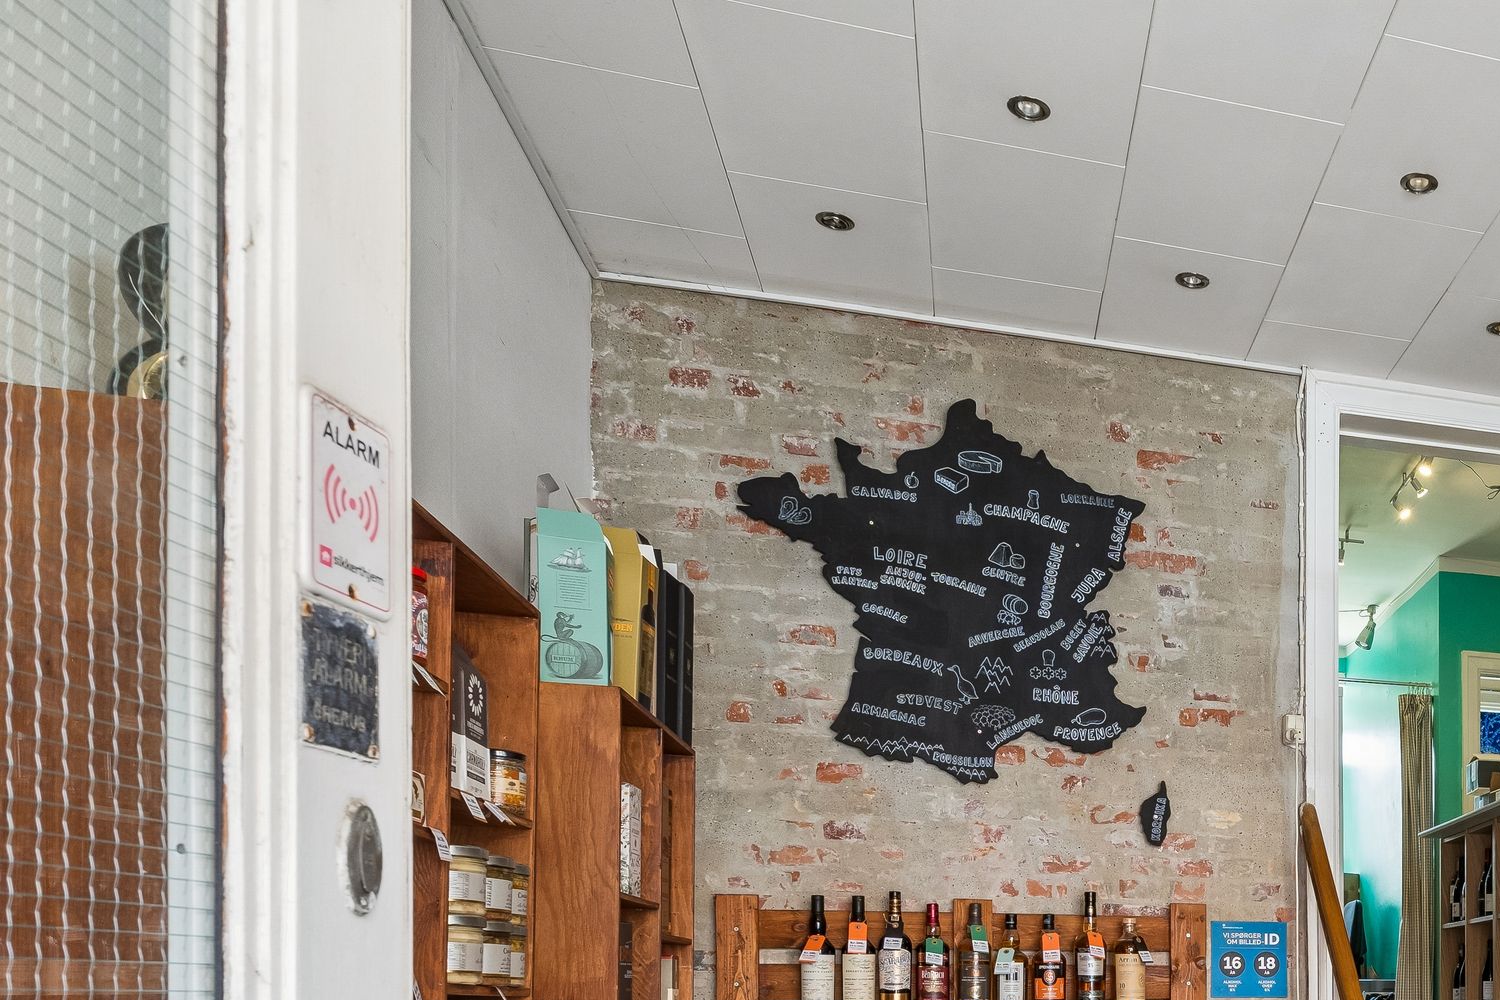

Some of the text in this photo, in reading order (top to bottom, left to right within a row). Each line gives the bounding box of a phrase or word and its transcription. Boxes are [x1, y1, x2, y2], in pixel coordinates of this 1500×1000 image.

[323, 421, 380, 469] ALARM
[852, 486, 918, 502] CALVADOS
[1061, 493, 1115, 508] LORRAINE
[984, 503, 1070, 534] CHAMPAGNE
[1107, 508, 1132, 562] ALSACE
[873, 546, 928, 570] LOIRE
[880, 574, 926, 595] SAUMUR
[931, 572, 986, 598] TOURAINE
[982, 566, 1025, 587] CENTRE
[1038, 543, 1064, 618] BOURGOGNE
[1071, 568, 1105, 603] JURA
[862, 603, 908, 624] COGNAC
[968, 626, 1025, 648] AUVERGNE
[1013, 619, 1066, 652] BEAUJOLAIS
[1060, 620, 1087, 651] BUGEY
[1072, 624, 1102, 664] SAVOIE
[553, 655, 574, 664] RHUM
[863, 647, 944, 676] BORDEAUX
[311, 658, 367, 694] ALARM
[896, 693, 964, 716] SYDVEST
[1033, 685, 1080, 706] RHÔNE
[851, 702, 926, 727] ARMAGNAC
[986, 713, 1044, 750] LANGUEDOC
[1054, 722, 1122, 740] PROVENCE
[932, 751, 994, 768] ROUSSILLON
[1224, 956, 1242, 970] 16
[1258, 956, 1276, 970] 18
